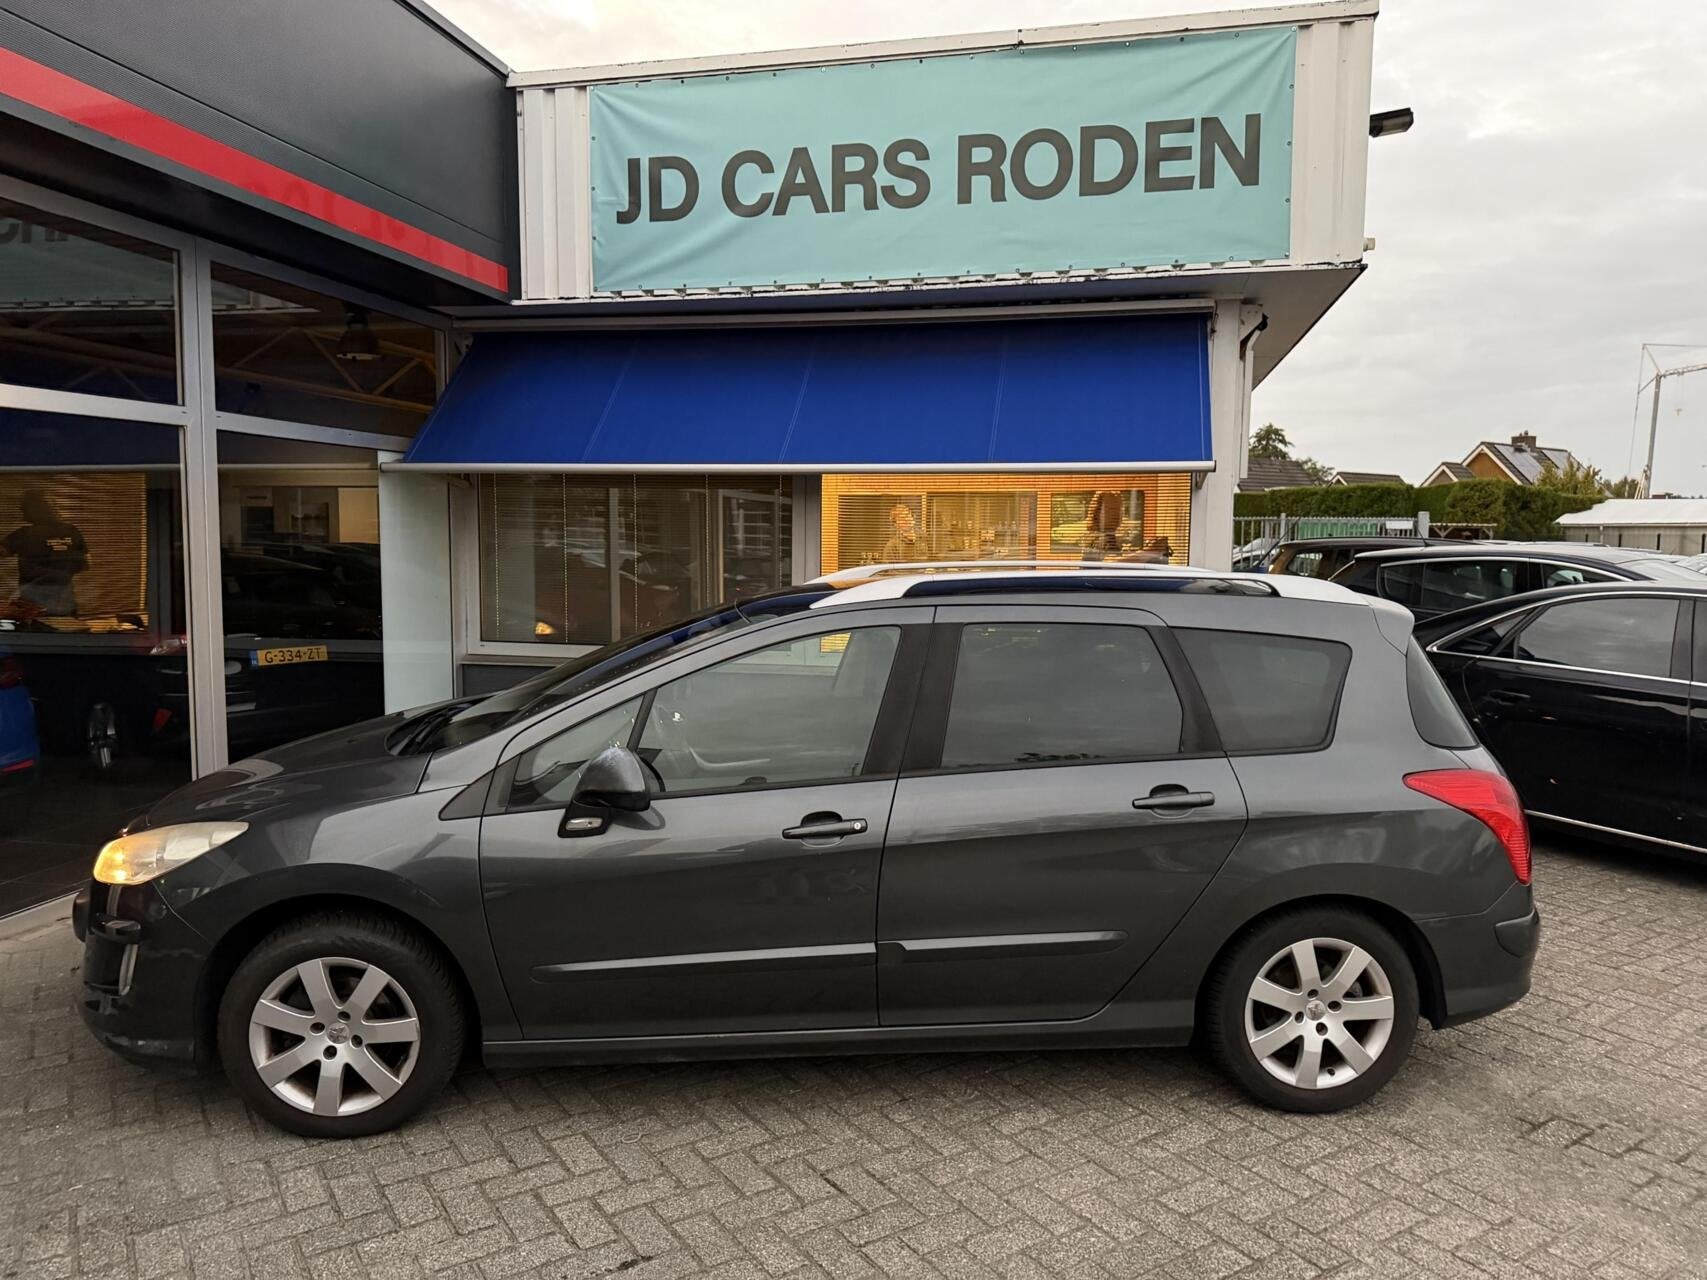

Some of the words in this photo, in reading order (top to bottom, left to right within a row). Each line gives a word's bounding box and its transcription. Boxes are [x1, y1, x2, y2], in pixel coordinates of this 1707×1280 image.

[616, 156, 700, 225] JD
[721, 138, 931, 218] CARS
[957, 112, 1262, 205] RODEN
[264, 647, 322, 664] G-334-ZT
